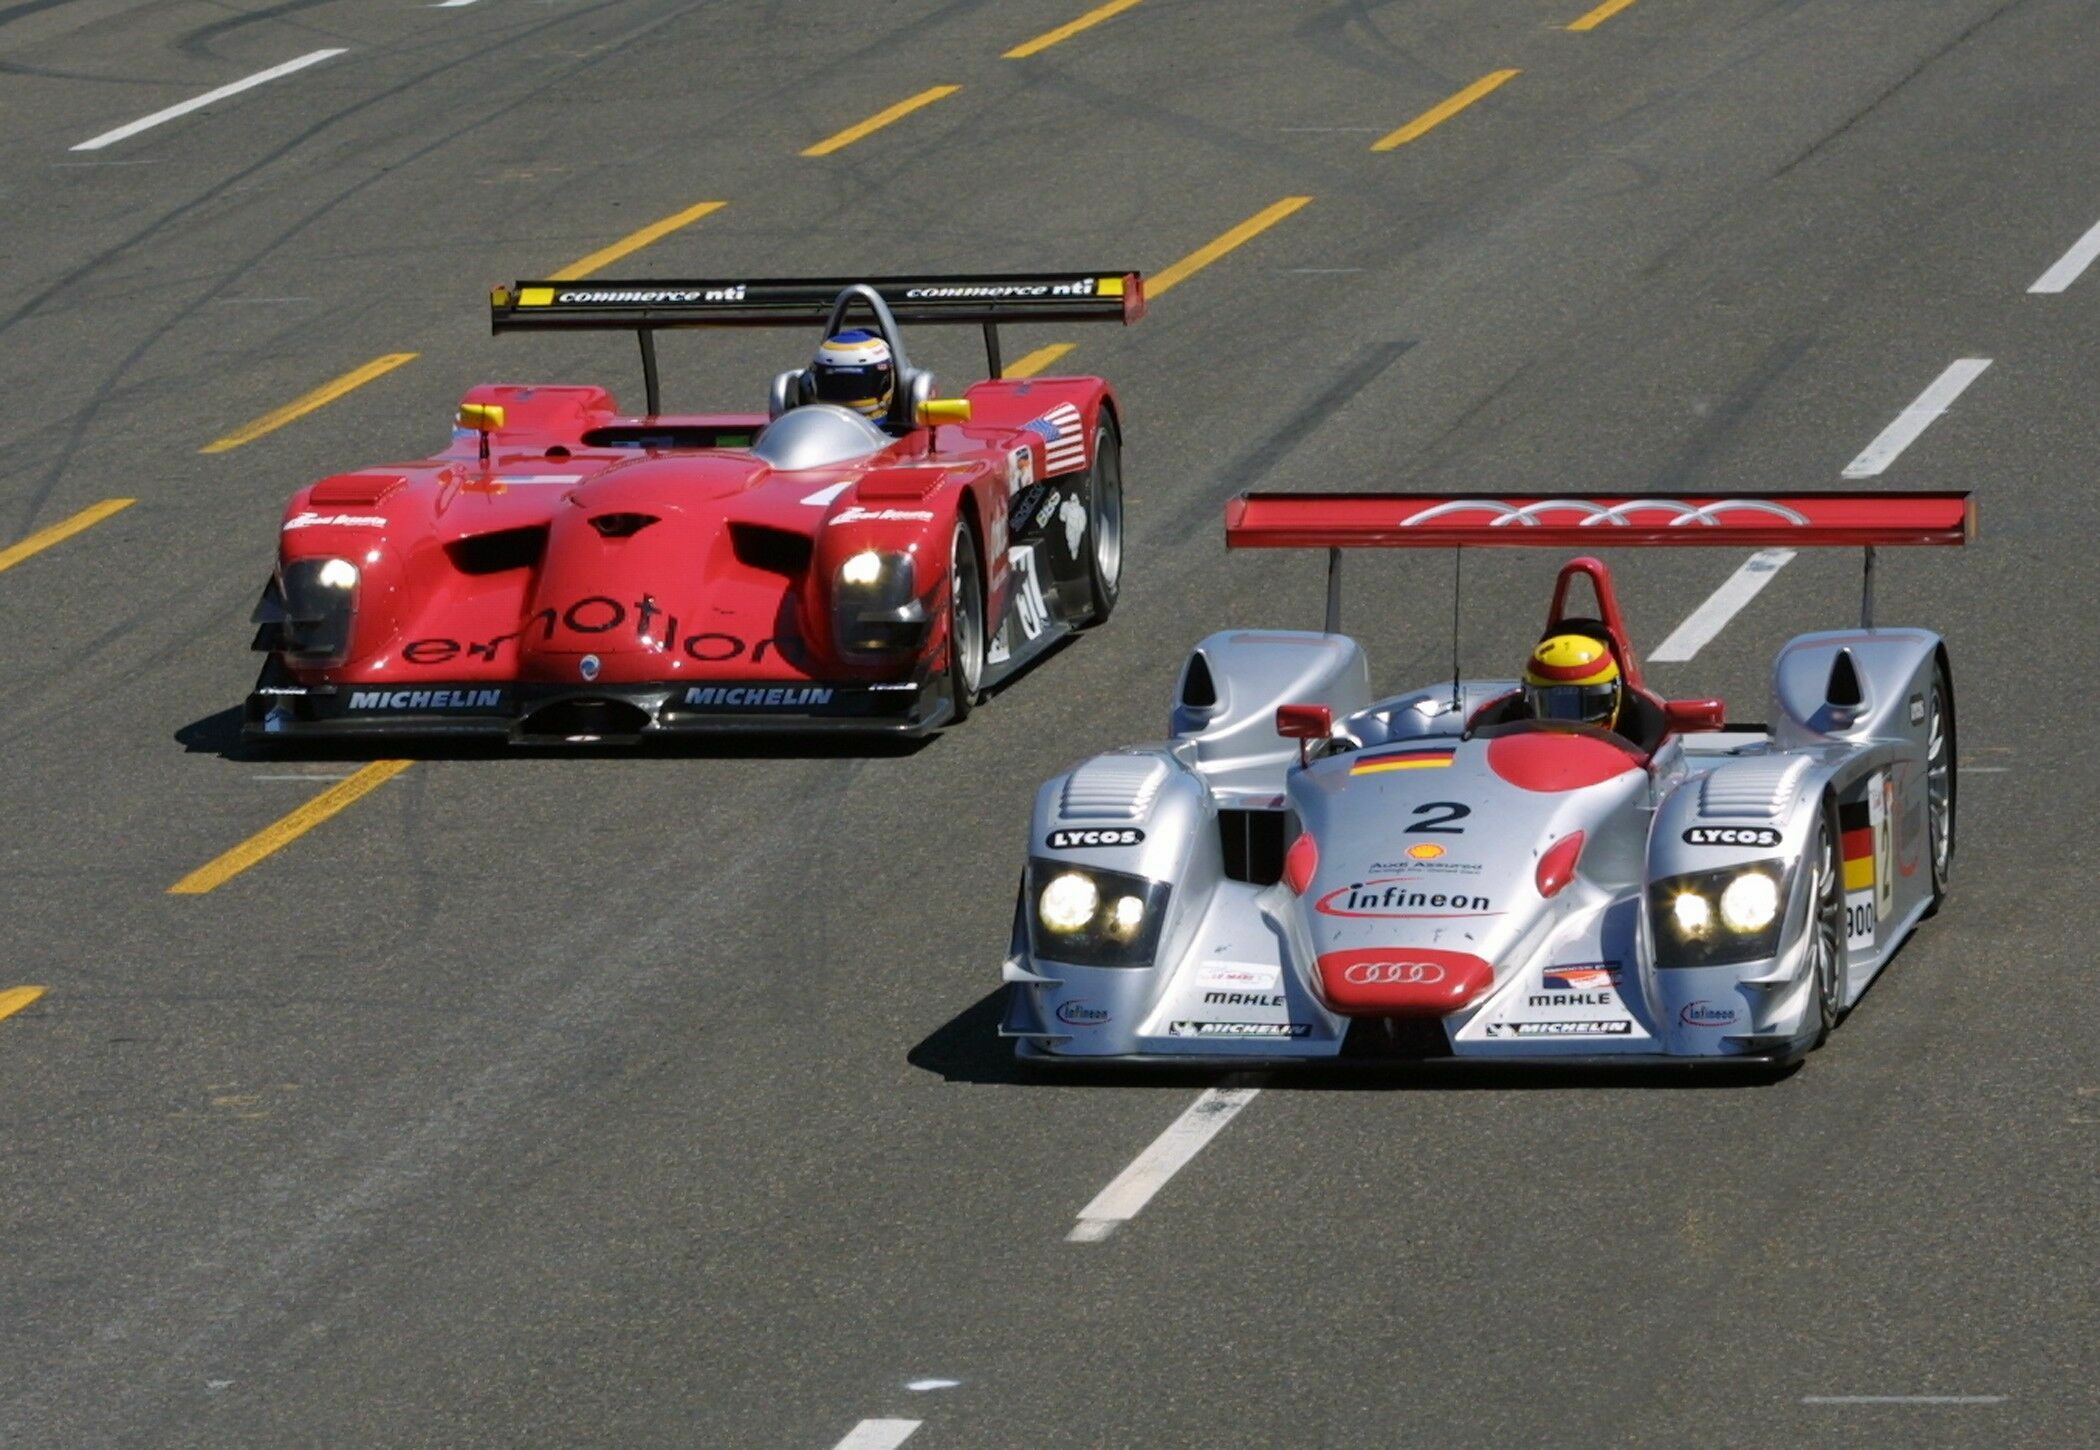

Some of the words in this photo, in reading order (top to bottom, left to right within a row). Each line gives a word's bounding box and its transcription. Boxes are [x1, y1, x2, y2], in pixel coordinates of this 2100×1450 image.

[559, 289, 700, 304] commerce
[705, 285, 747, 302] nti
[906, 284, 1048, 299] commerce
[1052, 278, 1094, 295] nti
[349, 689, 500, 709] MICHELIN
[684, 687, 834, 705] MICHELIN
[1404, 801, 1471, 834] 2
[1053, 830, 1136, 847] LYCOS
[1690, 828, 1774, 845] LYCOS
[1203, 992, 1286, 1007] MAHLE
[1529, 992, 1611, 1007] MAHLE
[1201, 1022, 1306, 1036] MICHELIN
[1518, 1021, 1628, 1034] MICHELIN
